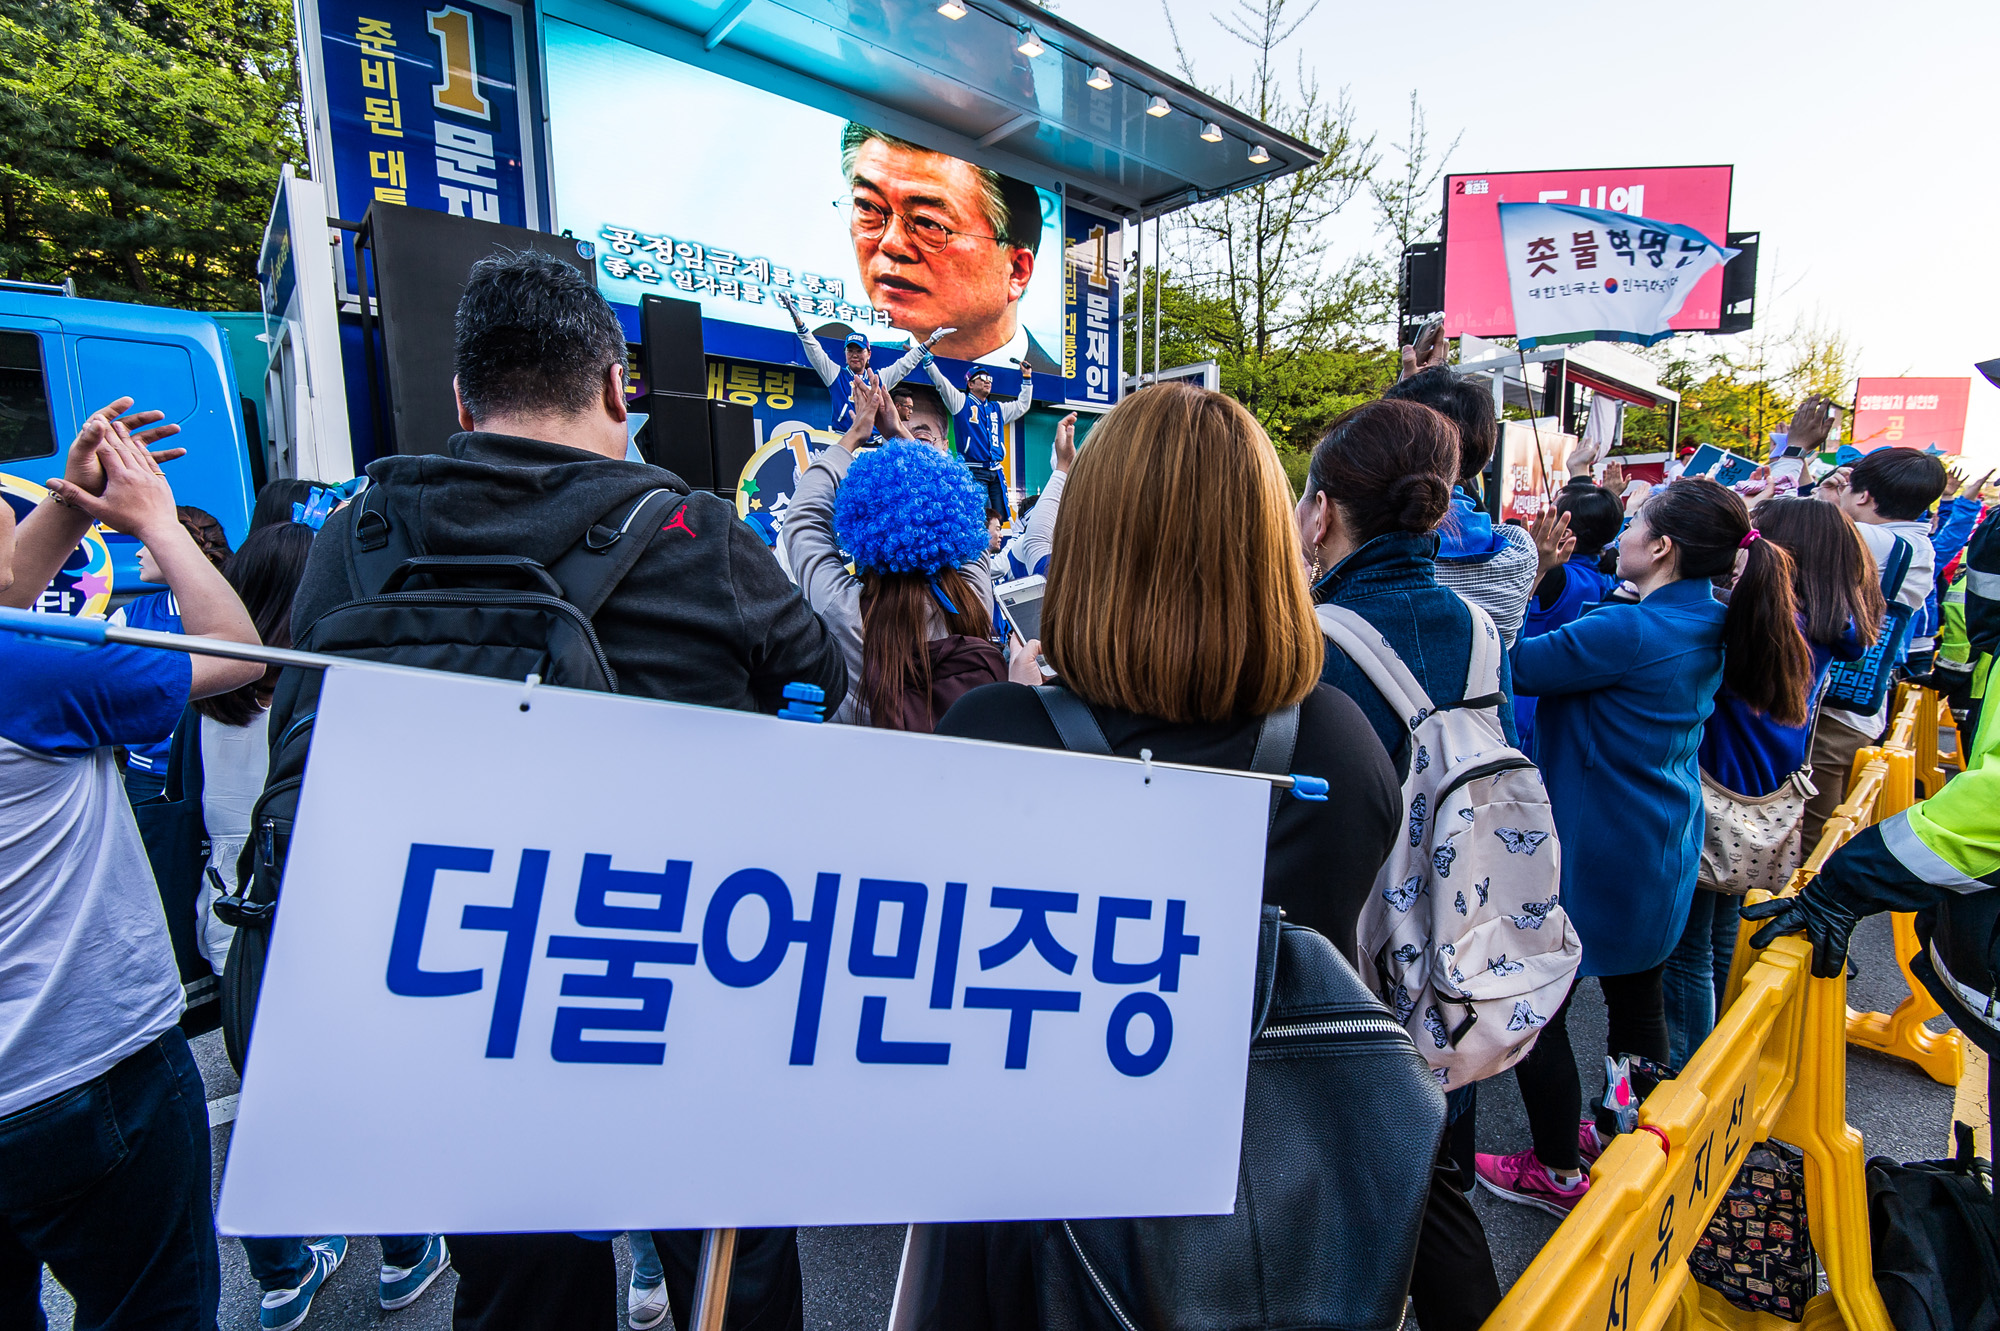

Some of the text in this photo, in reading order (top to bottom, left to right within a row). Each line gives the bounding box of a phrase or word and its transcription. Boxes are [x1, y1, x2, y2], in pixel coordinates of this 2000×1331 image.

[355, 16, 403, 138] 준비된
[426, 4, 491, 121] 1
[601, 224, 844, 298] 공정임금제를 통해
[602, 256, 660, 284] 좋은
[671, 270, 764, 303] 일자리를
[1087, 223, 1109, 290] 1
[1528, 280, 1600, 299] 대한민국은
[1085, 292, 1110, 401] 문재인
[969, 405, 979, 424] 1
[1884, 415, 1905, 441] 공
[386, 843, 1200, 1078] 더불어민주당
